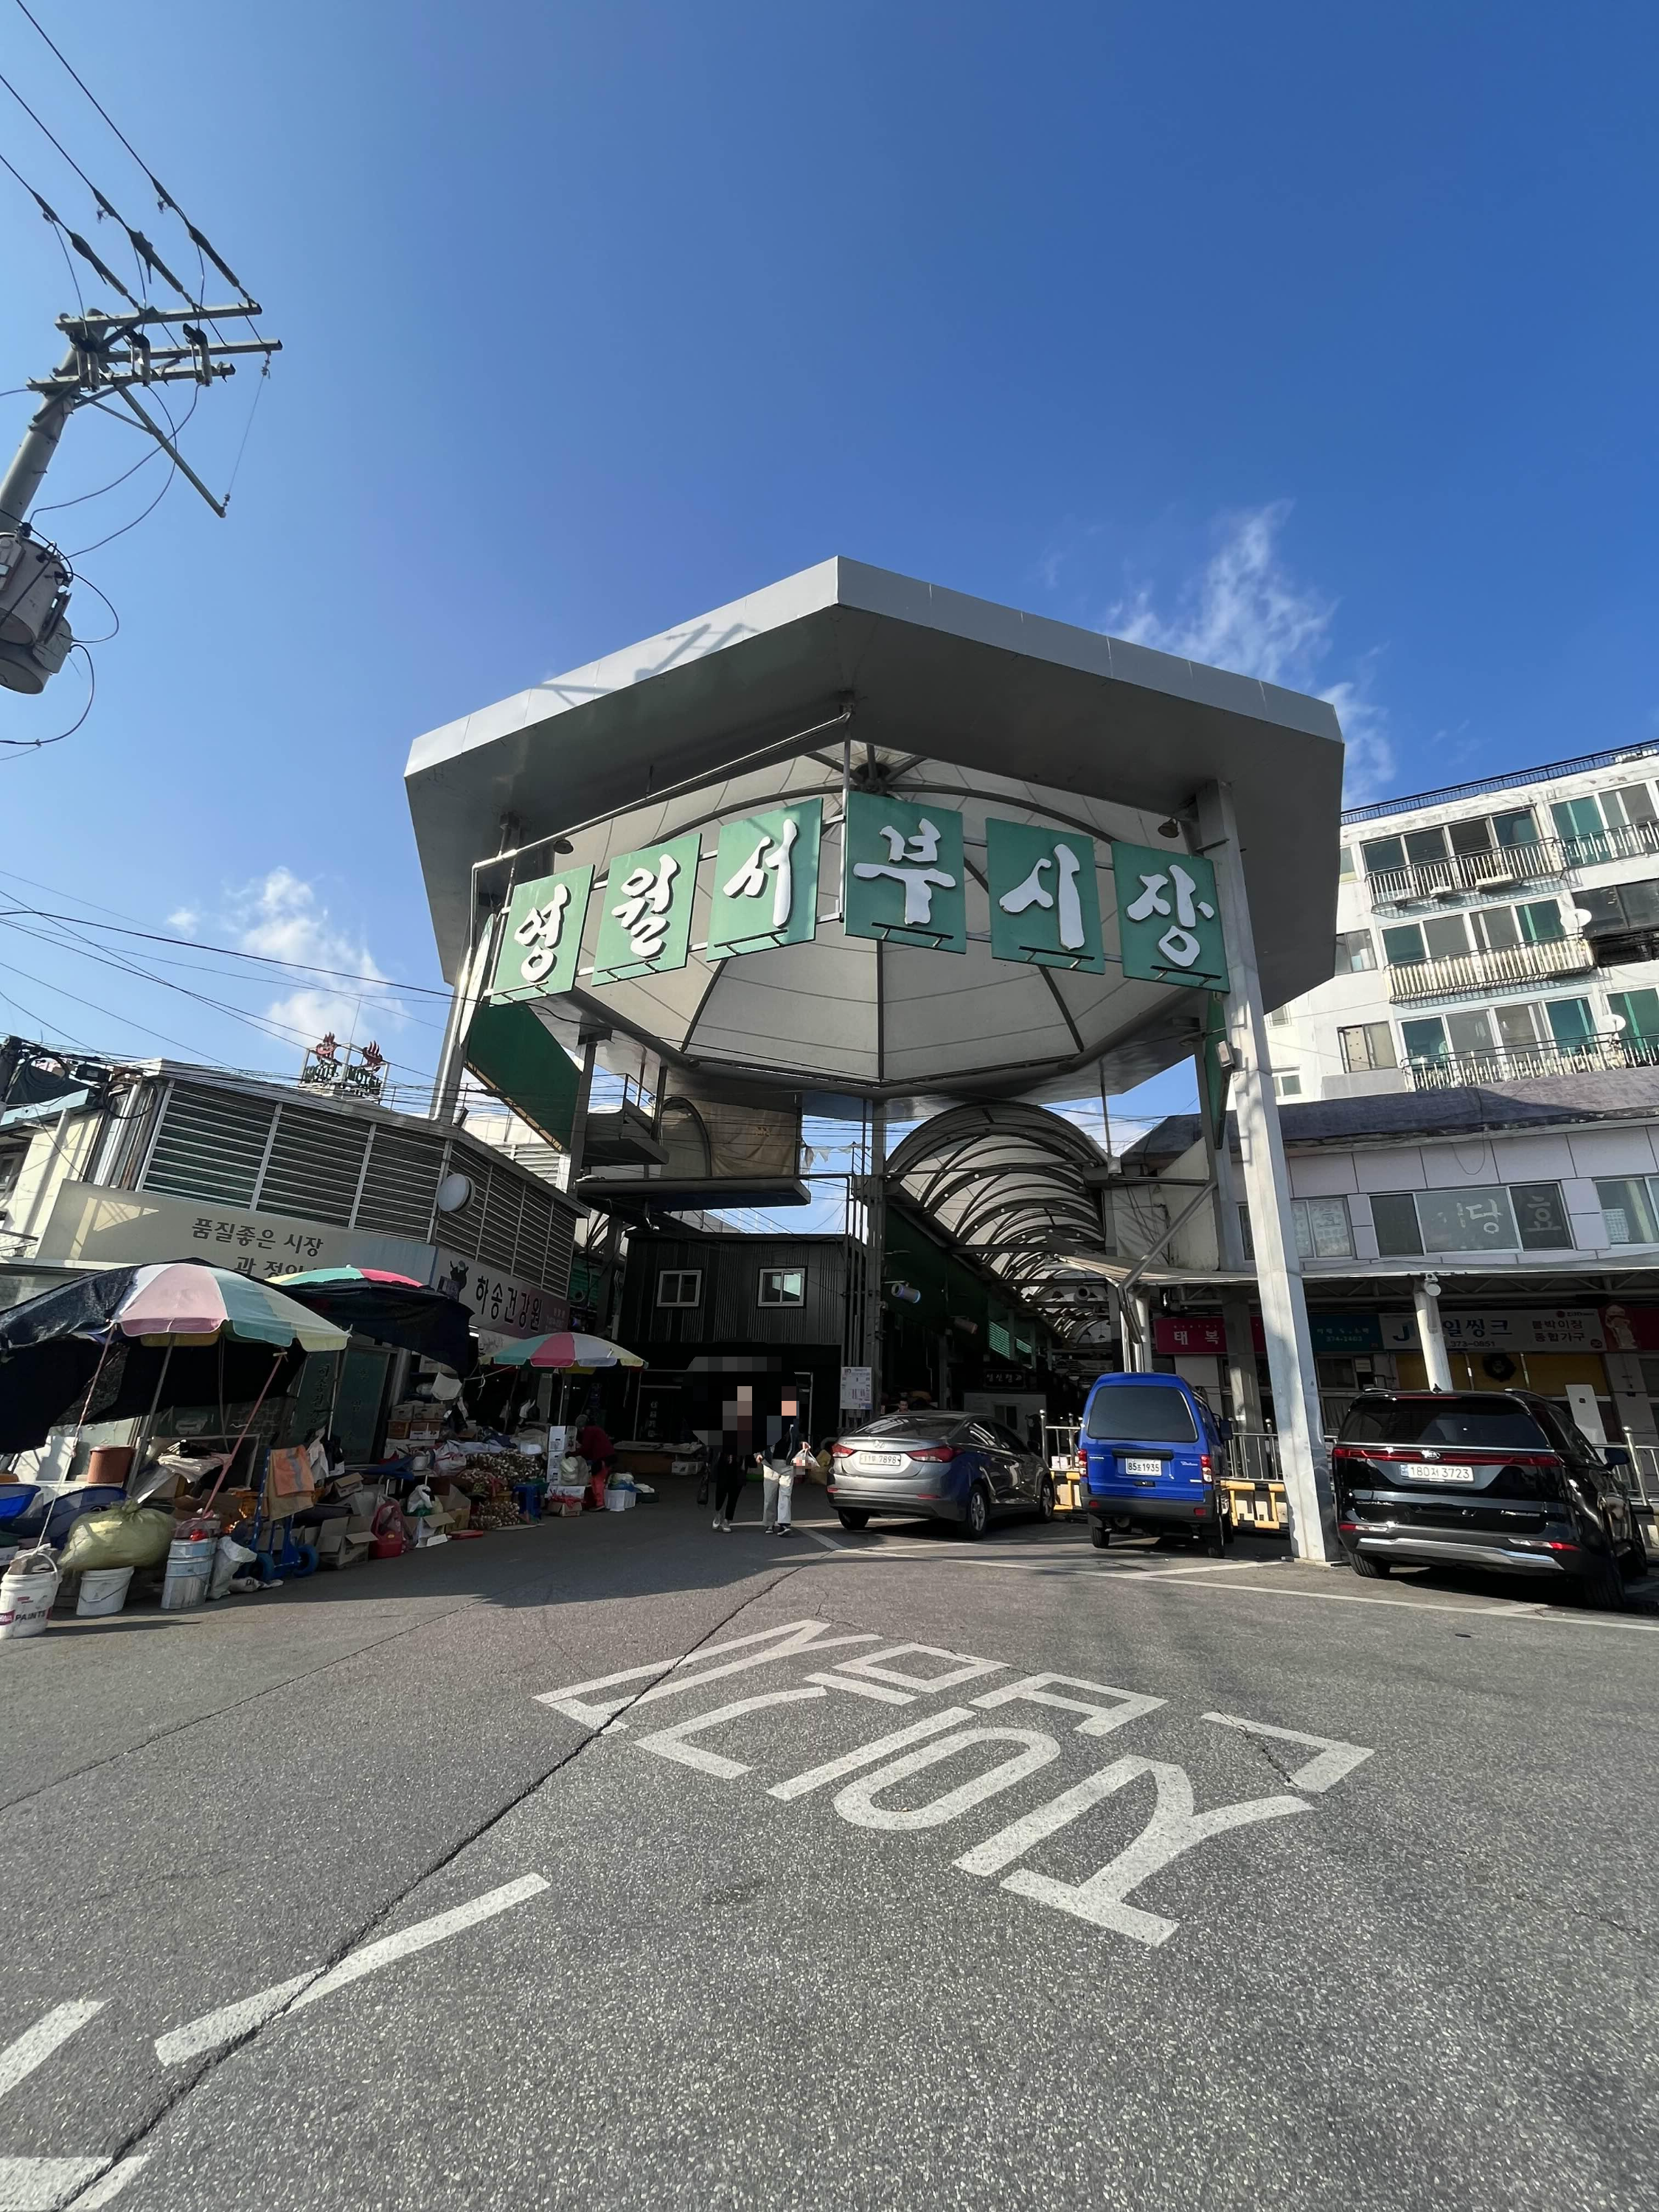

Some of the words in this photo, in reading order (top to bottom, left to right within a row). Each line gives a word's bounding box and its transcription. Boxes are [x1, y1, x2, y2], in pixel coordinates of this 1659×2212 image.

[192, 1217, 276, 1250] 품질좋은
[284, 1234, 324, 1257] 시장
[476, 1276, 542, 1332] 하송건강원
